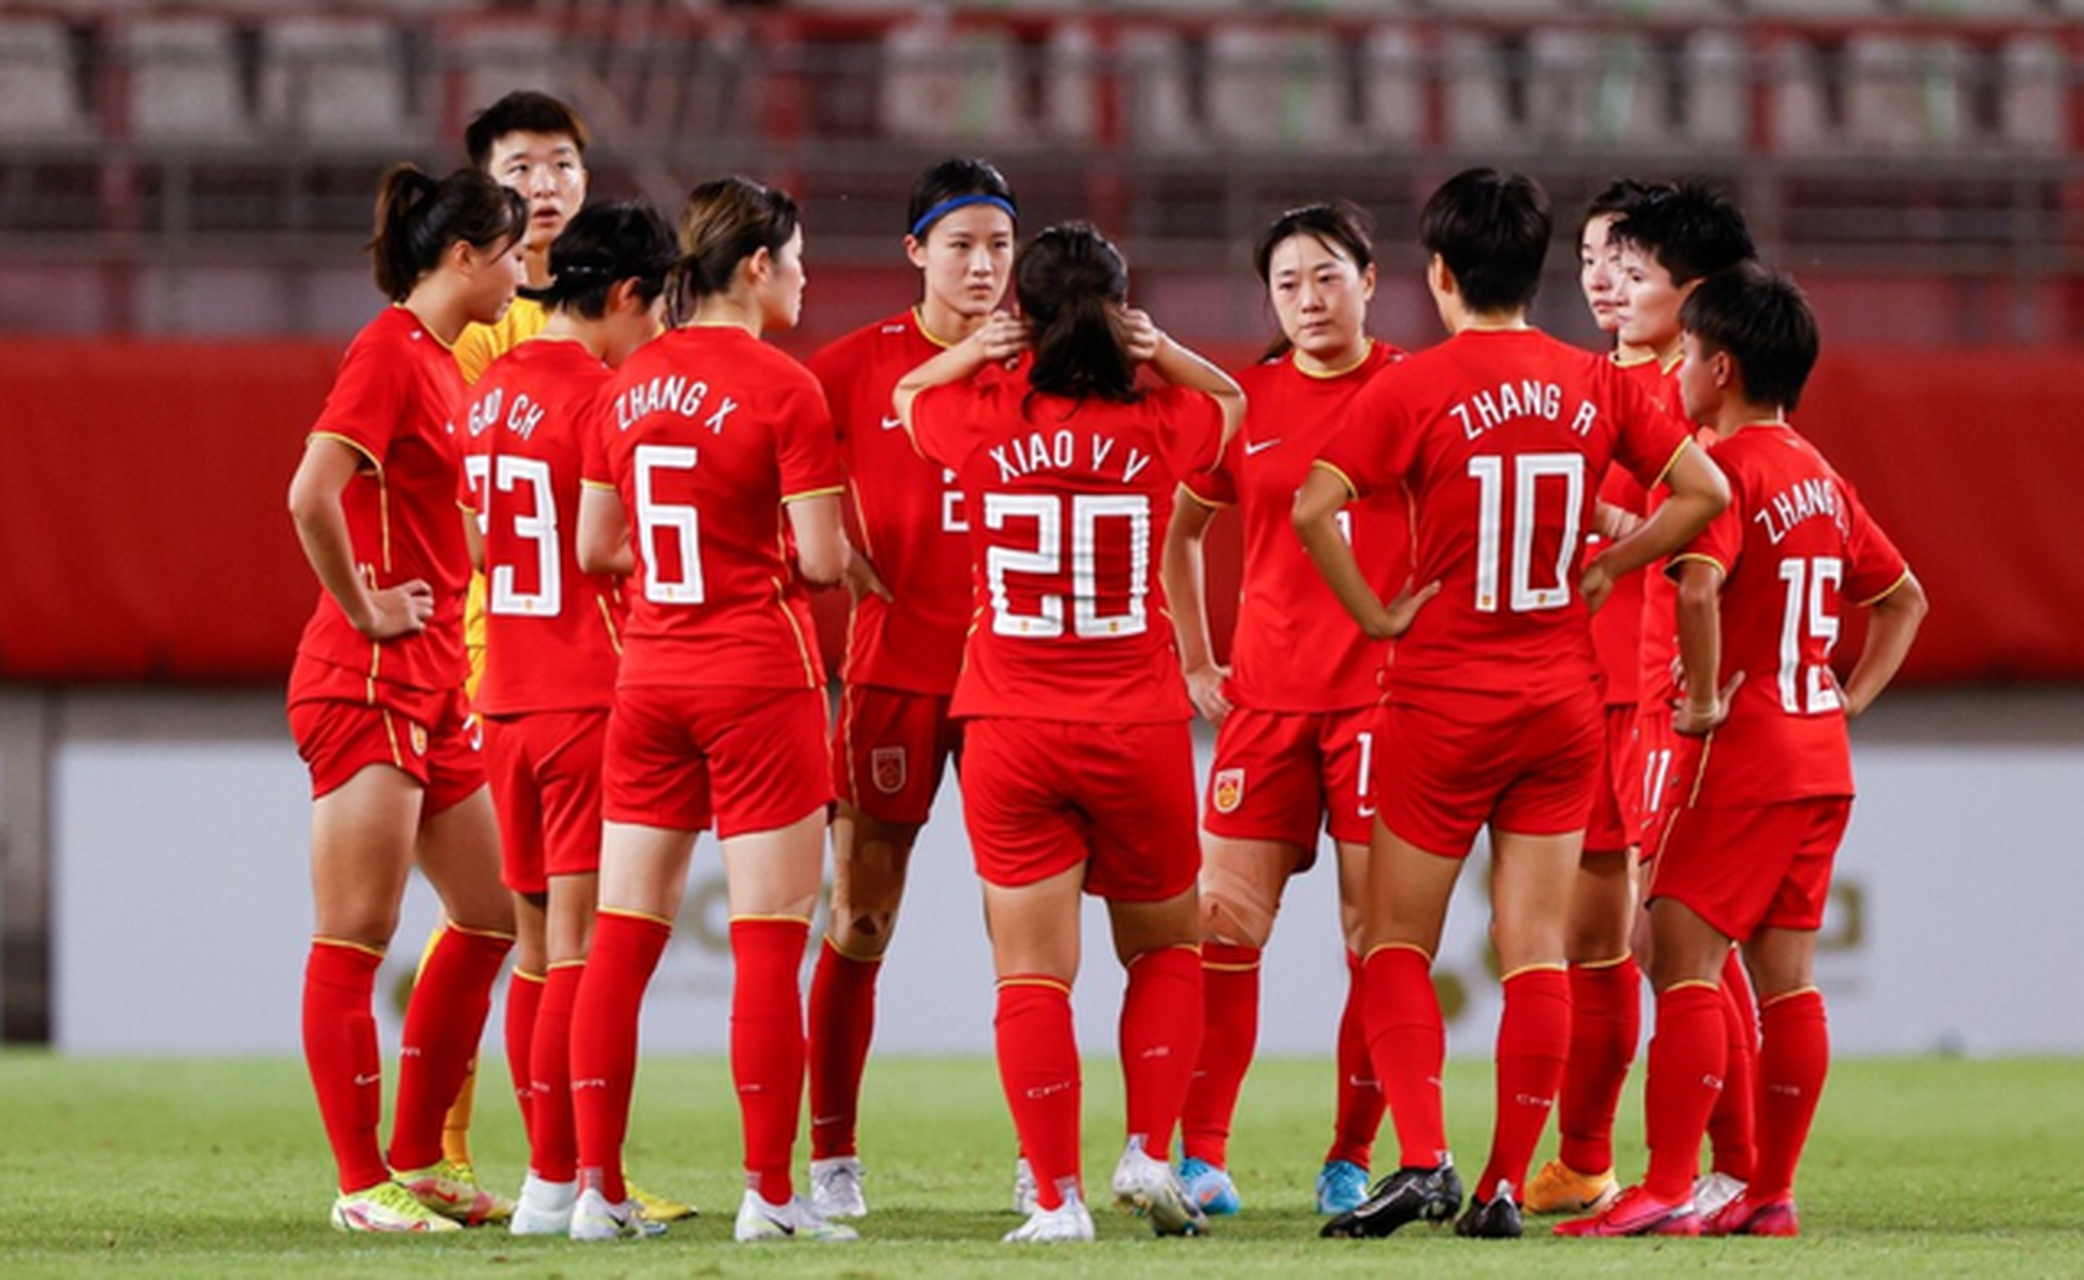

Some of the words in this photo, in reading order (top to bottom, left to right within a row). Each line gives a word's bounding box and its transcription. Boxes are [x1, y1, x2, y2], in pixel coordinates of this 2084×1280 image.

[507, 393, 546, 441] CH
[614, 375, 708, 431] ZHANG
[706, 397, 737, 434] X
[1449, 379, 1562, 440] ZHANG
[1571, 401, 1597, 437] R
[988, 429, 1074, 484] XIAO
[1092, 433, 1114, 472] Y
[634, 443, 706, 605] 6
[1467, 452, 1585, 612] 10
[983, 493, 1151, 638] 20
[1777, 556, 1843, 715] 15
[1641, 748, 1673, 814] 11
